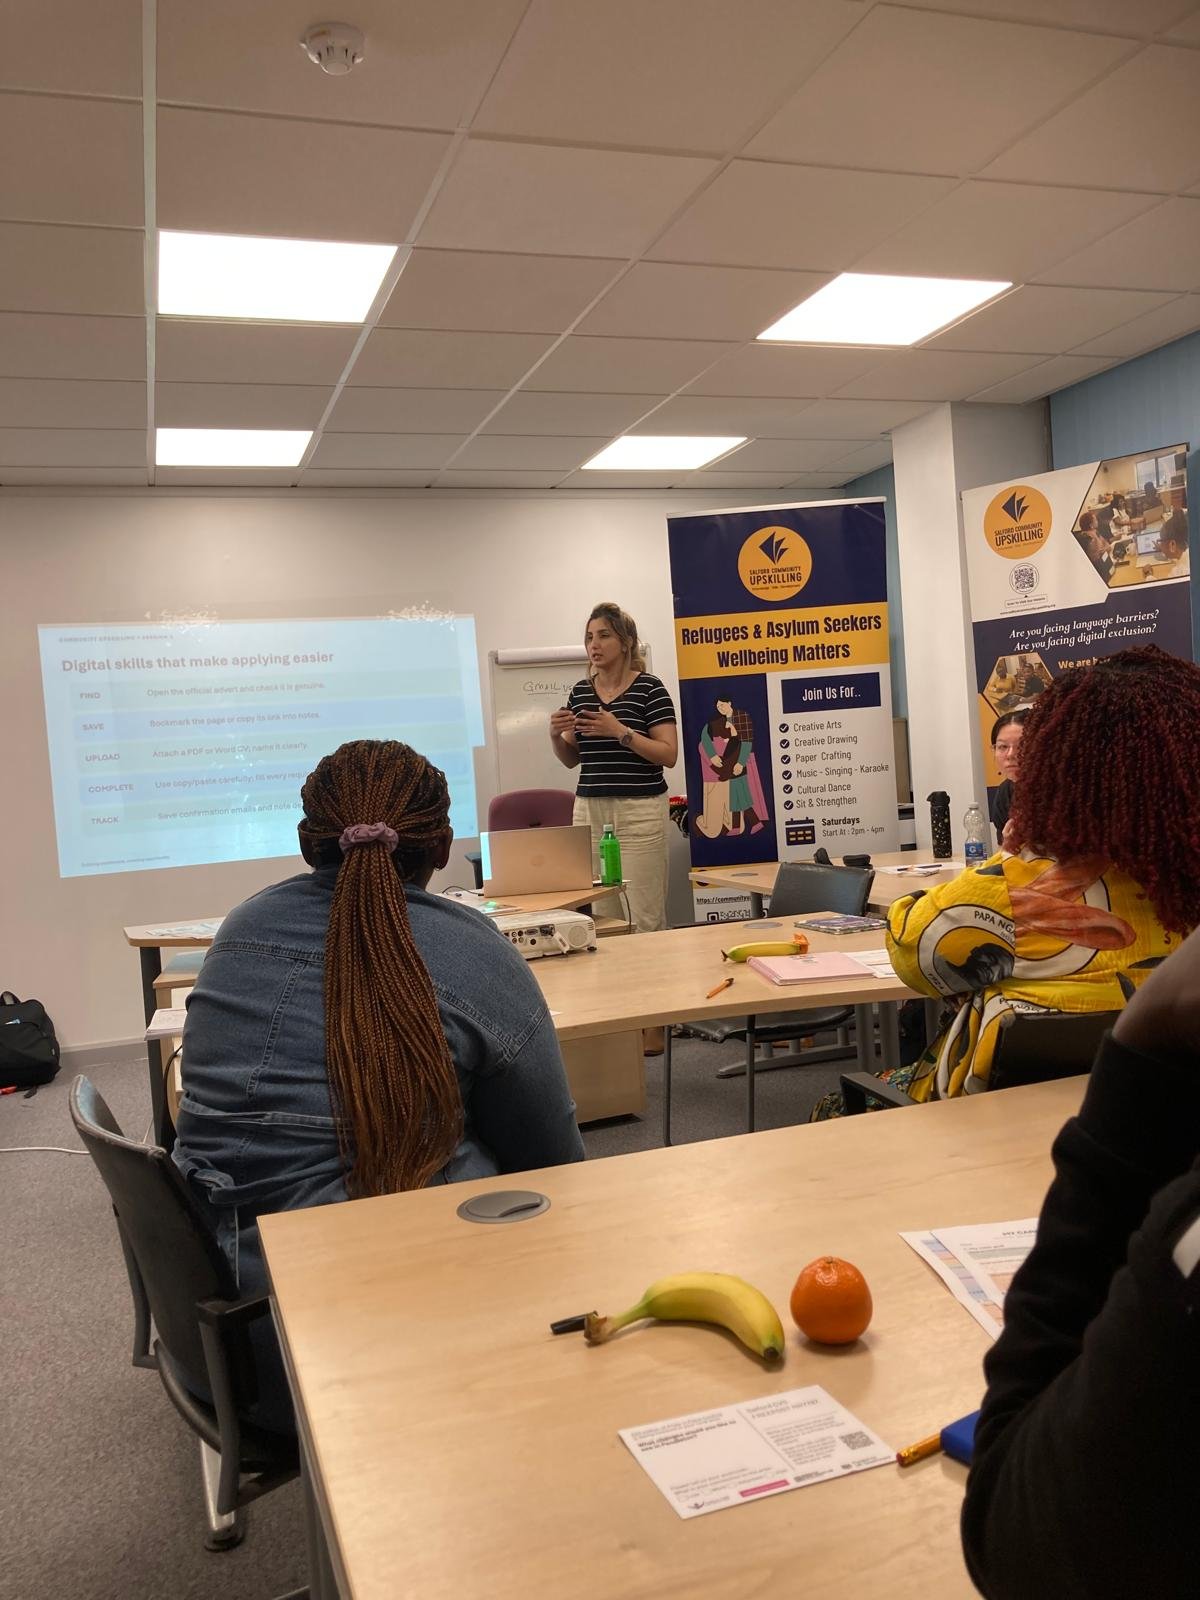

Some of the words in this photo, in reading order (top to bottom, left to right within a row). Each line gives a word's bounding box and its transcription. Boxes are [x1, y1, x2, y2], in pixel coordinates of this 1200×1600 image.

[994, 527, 1014, 537] SALFORD
[1015, 521, 1043, 533] COMMUNITY
[995, 528, 1043, 547] UPSKILLING
[749, 572, 802, 585] UPSKILLING
[681, 625, 749, 645] Refugees
[753, 624, 762, 639] &
[766, 619, 820, 640] Asylum
[823, 615, 882, 633] Seekers
[1009, 630, 1025, 639] Are
[1025, 628, 1041, 639] you
[1043, 624, 1070, 637] facing
[1073, 617, 1113, 633] language
[1115, 609, 1159, 624] barriers?
[1013, 642, 1029, 651] Are
[1030, 640, 1046, 652] you
[1047, 636, 1075, 650] facing
[1077, 629, 1106, 645] digital
[1108, 623, 1157, 638] exclusion?
[717, 647, 789, 667] Wellbeing
[793, 643, 850, 662] Matters
[62, 659, 111, 673] Digital
[114, 657, 153, 670] skills
[156, 657, 186, 668] that
[190, 655, 228, 668] make
[232, 653, 291, 668] applying
[293, 651, 334, 664] easier
[1058, 659, 1074, 669] We
[1076, 659, 1091, 667] are
[80, 692, 101, 700] FIND
[147, 688, 169, 697] Open
[170, 688, 184, 696] the
[185, 687, 212, 695] official
[214, 686, 238, 694] advert
[802, 687, 823, 702] Join
[825, 687, 837, 699] Us
[82, 723, 104, 731] SAVE
[150, 718, 190, 727] Bookmark
[192, 718, 205, 726] the
[206, 717, 225, 726] page
[236, 716, 255, 724] copy
[793, 722, 824, 732] Creative
[826, 721, 842, 730] Arts
[794, 737, 825, 747] Creative
[827, 735, 858, 745] Drawing
[85, 753, 120, 762] UPLOAD
[153, 750, 179, 758] Attach
[187, 747, 203, 756] PDF
[214, 745, 236, 753] Word
[795, 754, 817, 764] Paper
[821, 751, 852, 760] Crafting
[796, 769, 818, 778] Music
[825, 766, 853, 776] Singing
[860, 764, 889, 774] Karaoke
[88, 783, 134, 793] COMPLETE
[797, 784, 826, 795] Cultural
[828, 783, 851, 792] Dance
[796, 799, 806, 809] Sit
[808, 799, 814, 807] &
[816, 796, 857, 807] Strengthen
[179, 807, 229, 818] confirmation
[231, 805, 256, 814] emails
[91, 816, 119, 824] TRACK
[821, 817, 860, 827] Saturdays
[822, 829, 838, 837] Start
[851, 827, 865, 835] 2pm
[974, 910, 995, 925] PAPA
